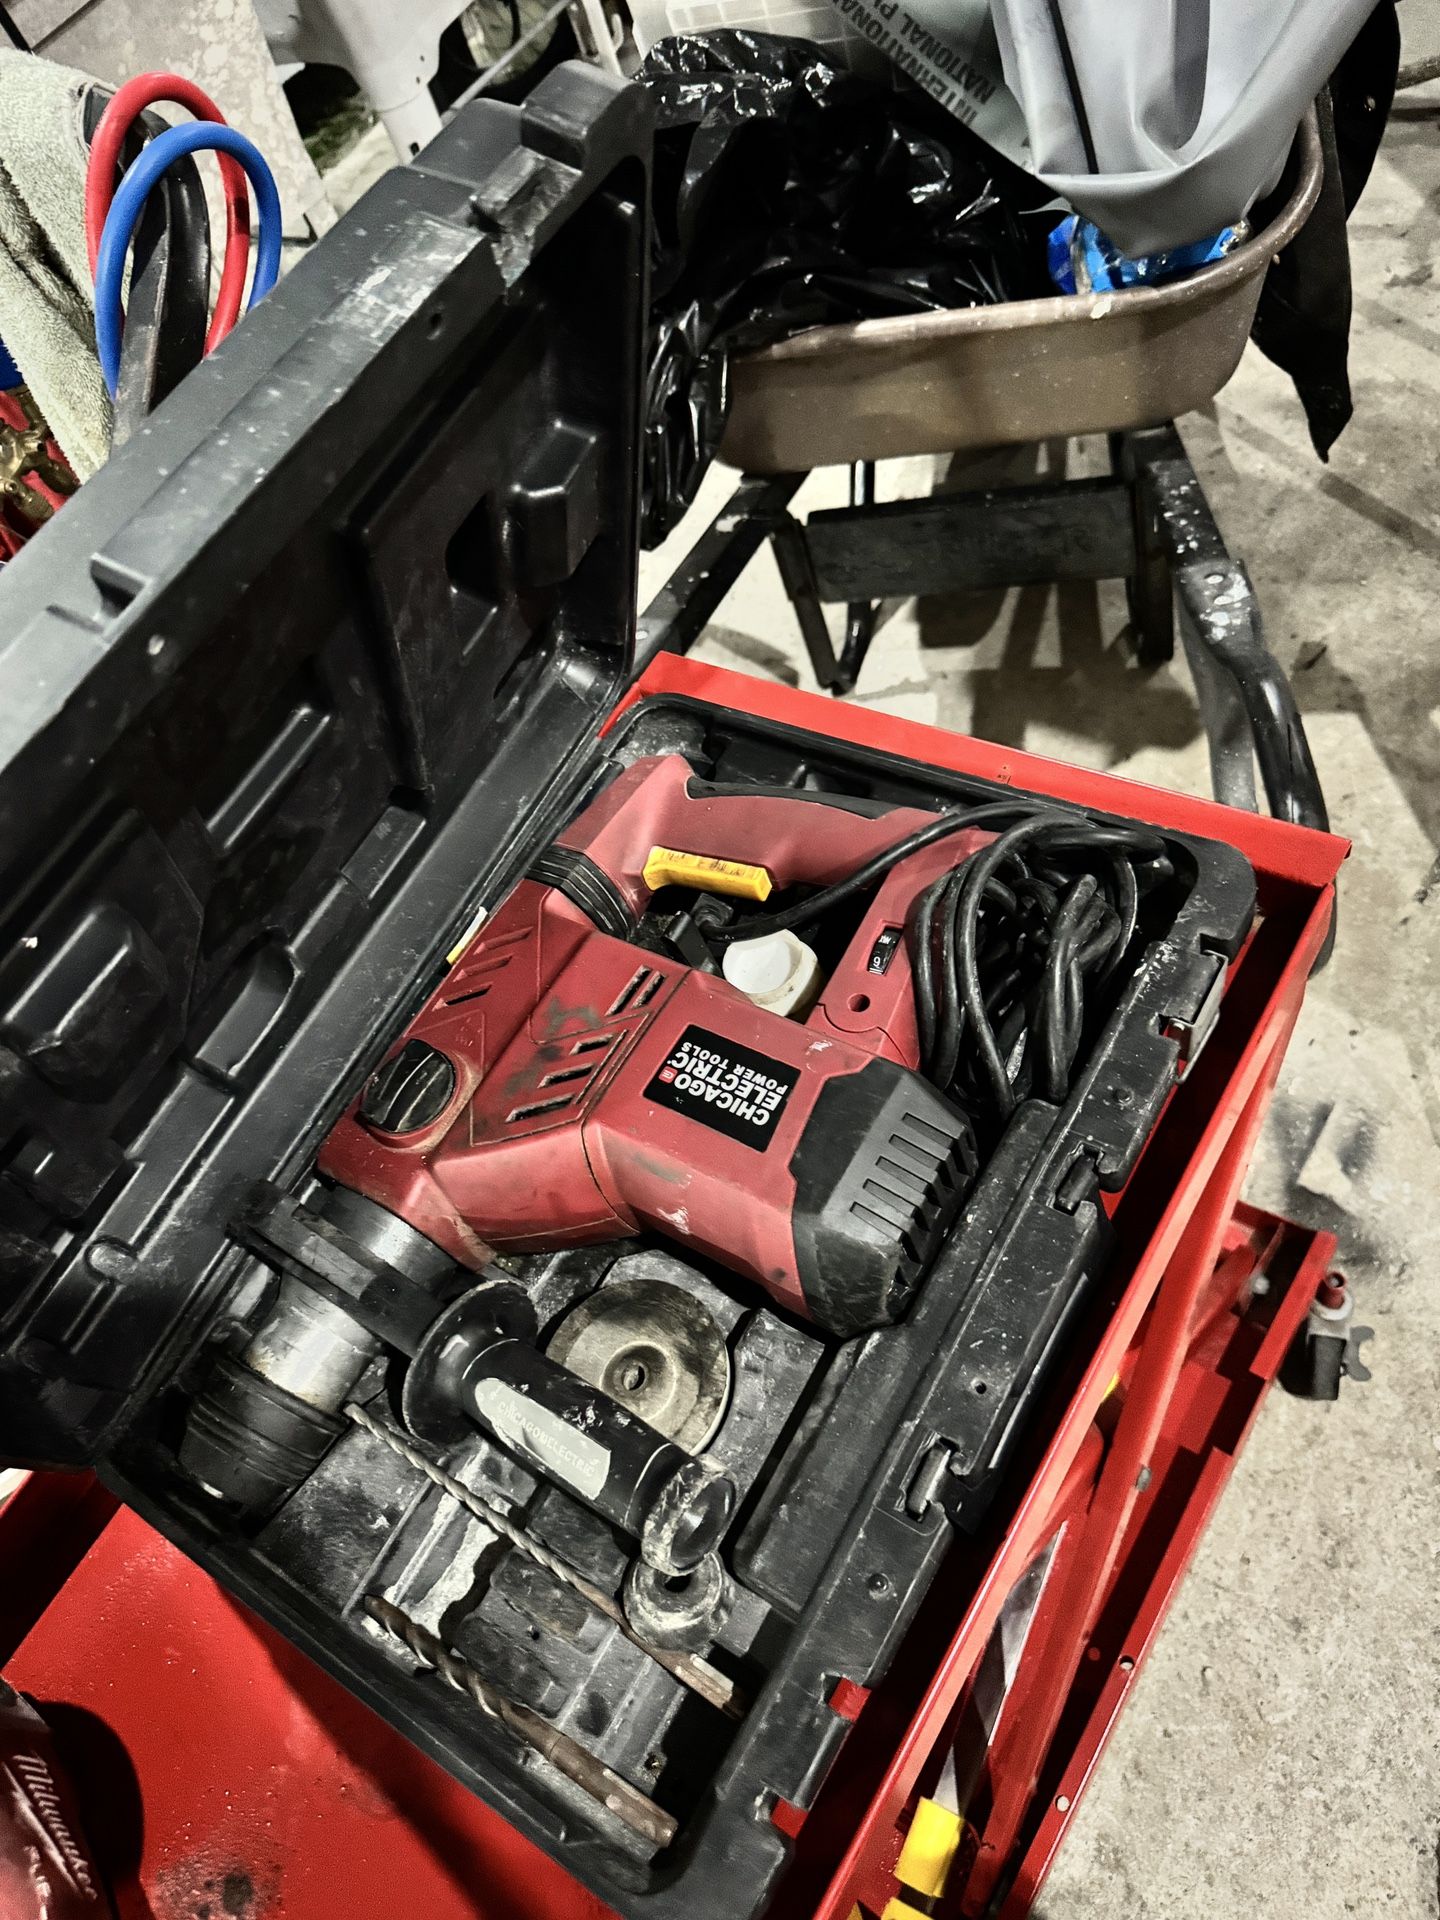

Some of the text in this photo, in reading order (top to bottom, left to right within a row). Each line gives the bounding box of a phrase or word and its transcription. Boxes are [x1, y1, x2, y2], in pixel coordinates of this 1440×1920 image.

[833, 0, 978, 126] INTERNATIONA
[900, 12, 997, 105] NATIONAL
[669, 1051, 783, 1111] ELECTRIC
[673, 1072, 771, 1126] CHICAGO
[681, 1041, 789, 1095] POWER TOOLS
[12, 1754, 98, 1900] Milwaukee
